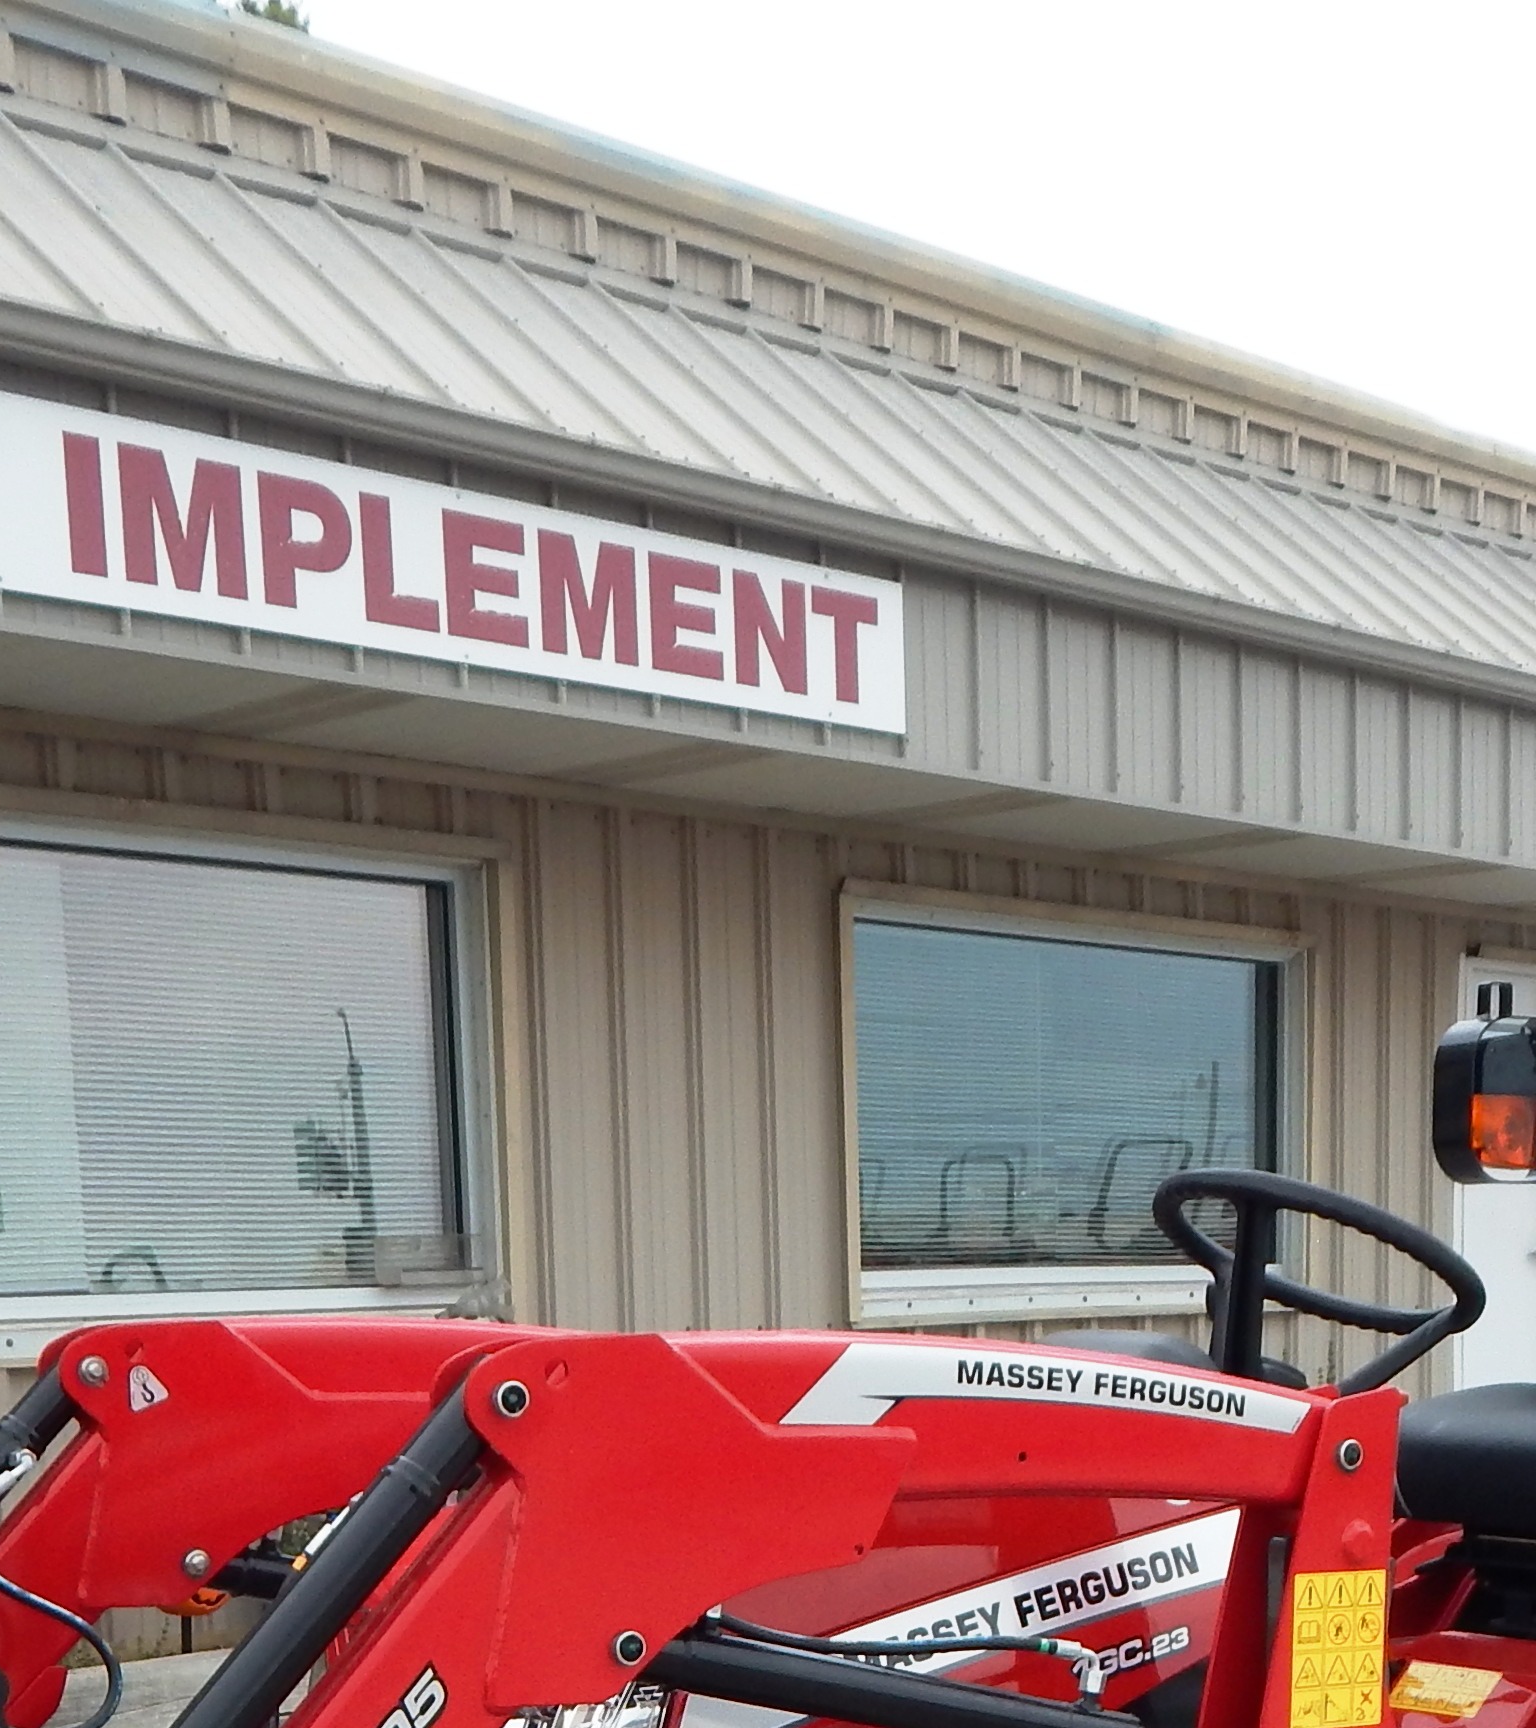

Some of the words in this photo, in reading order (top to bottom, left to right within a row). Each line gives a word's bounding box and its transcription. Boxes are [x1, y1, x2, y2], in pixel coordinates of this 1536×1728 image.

[62, 430, 878, 704] IMPLEMENT
[956, 1359, 1084, 1394] MASSEY
[1093, 1371, 1247, 1418] FERGUSON
[1013, 1542, 1200, 1629] FERGUSON
